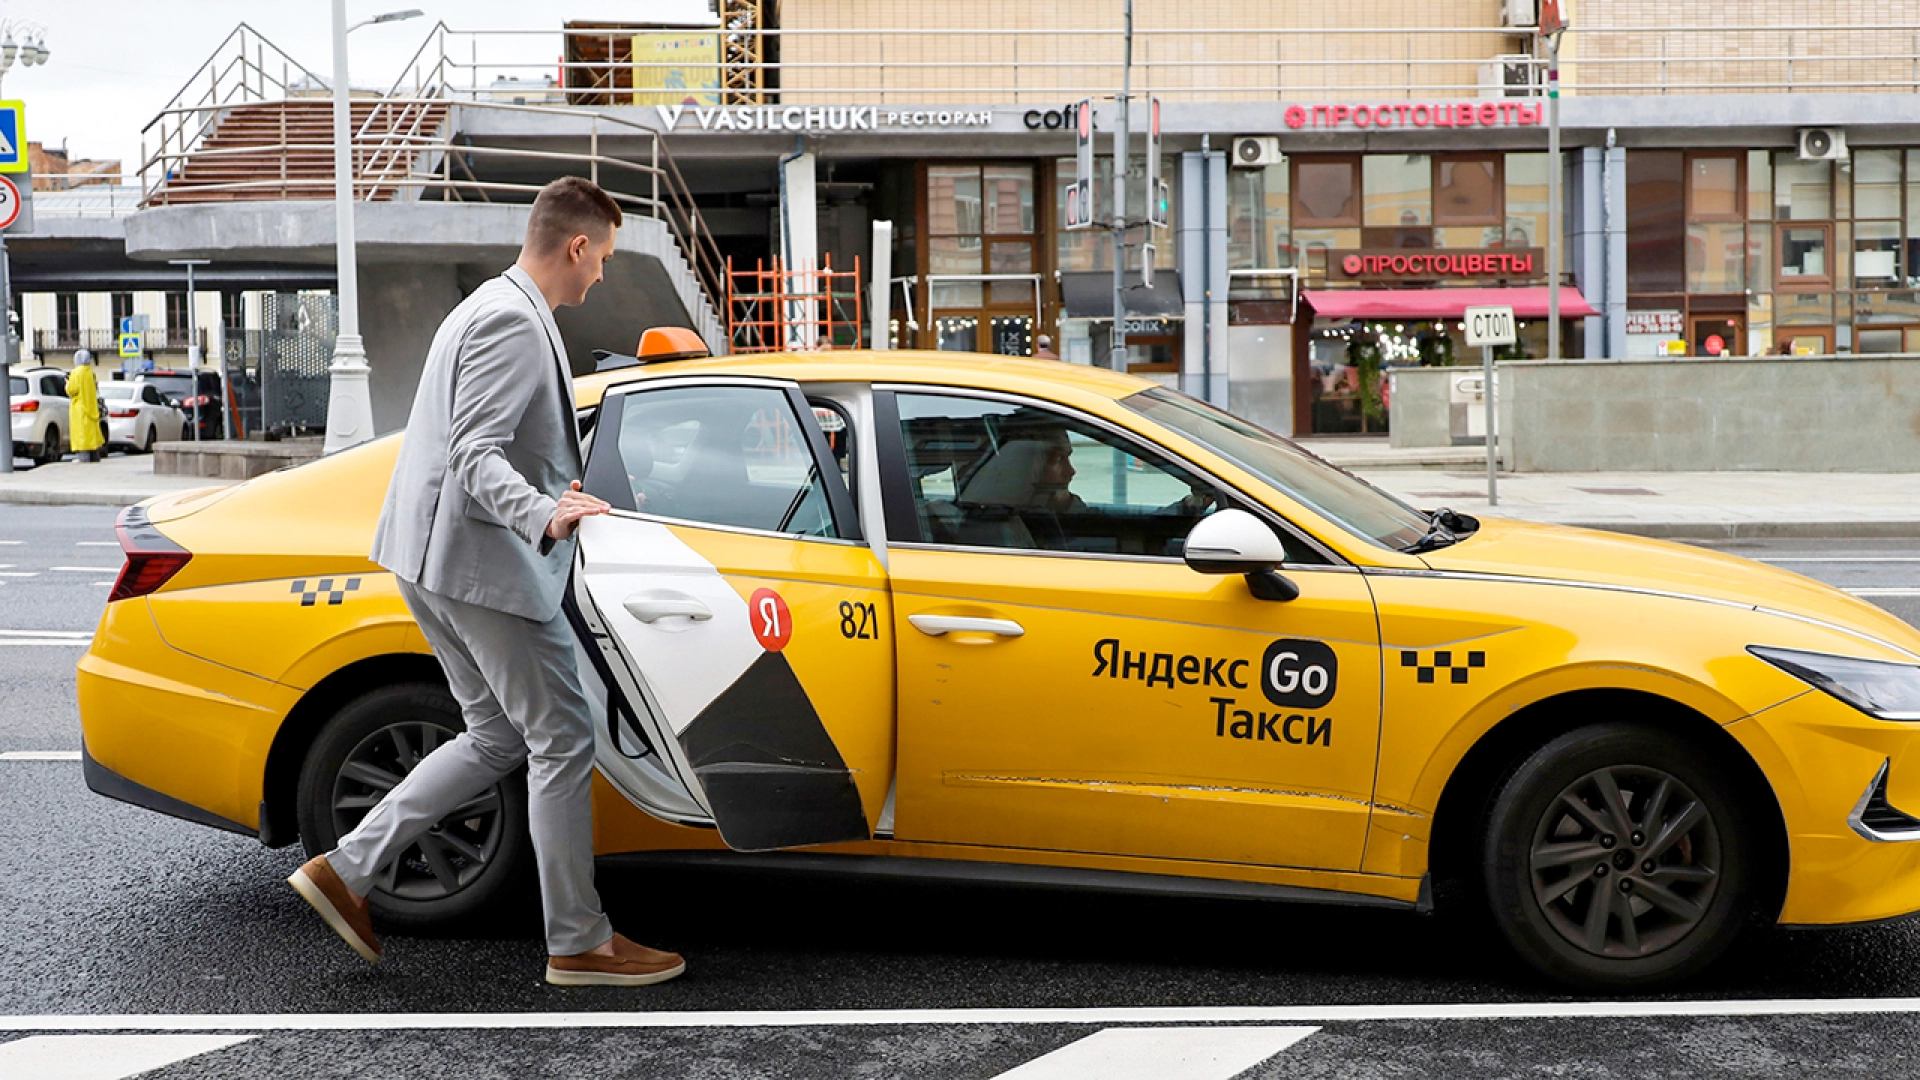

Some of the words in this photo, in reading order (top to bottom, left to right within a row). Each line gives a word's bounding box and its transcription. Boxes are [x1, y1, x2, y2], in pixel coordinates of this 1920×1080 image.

[695, 105, 877, 130] VASILCHUKI
[887, 110, 992, 125] РЕСТОРАН
[1023, 104, 1098, 130] cofi
[1363, 254, 1533, 275] ПРОСТОЦВЕТЫ
[1474, 313, 1510, 338] СТОП
[759, 597, 781, 637] Я
[839, 600, 879, 640] 821
[1092, 638, 1249, 689] Яндекс
[1269, 651, 1329, 696] Go
[1209, 696, 1332, 747] Такси
